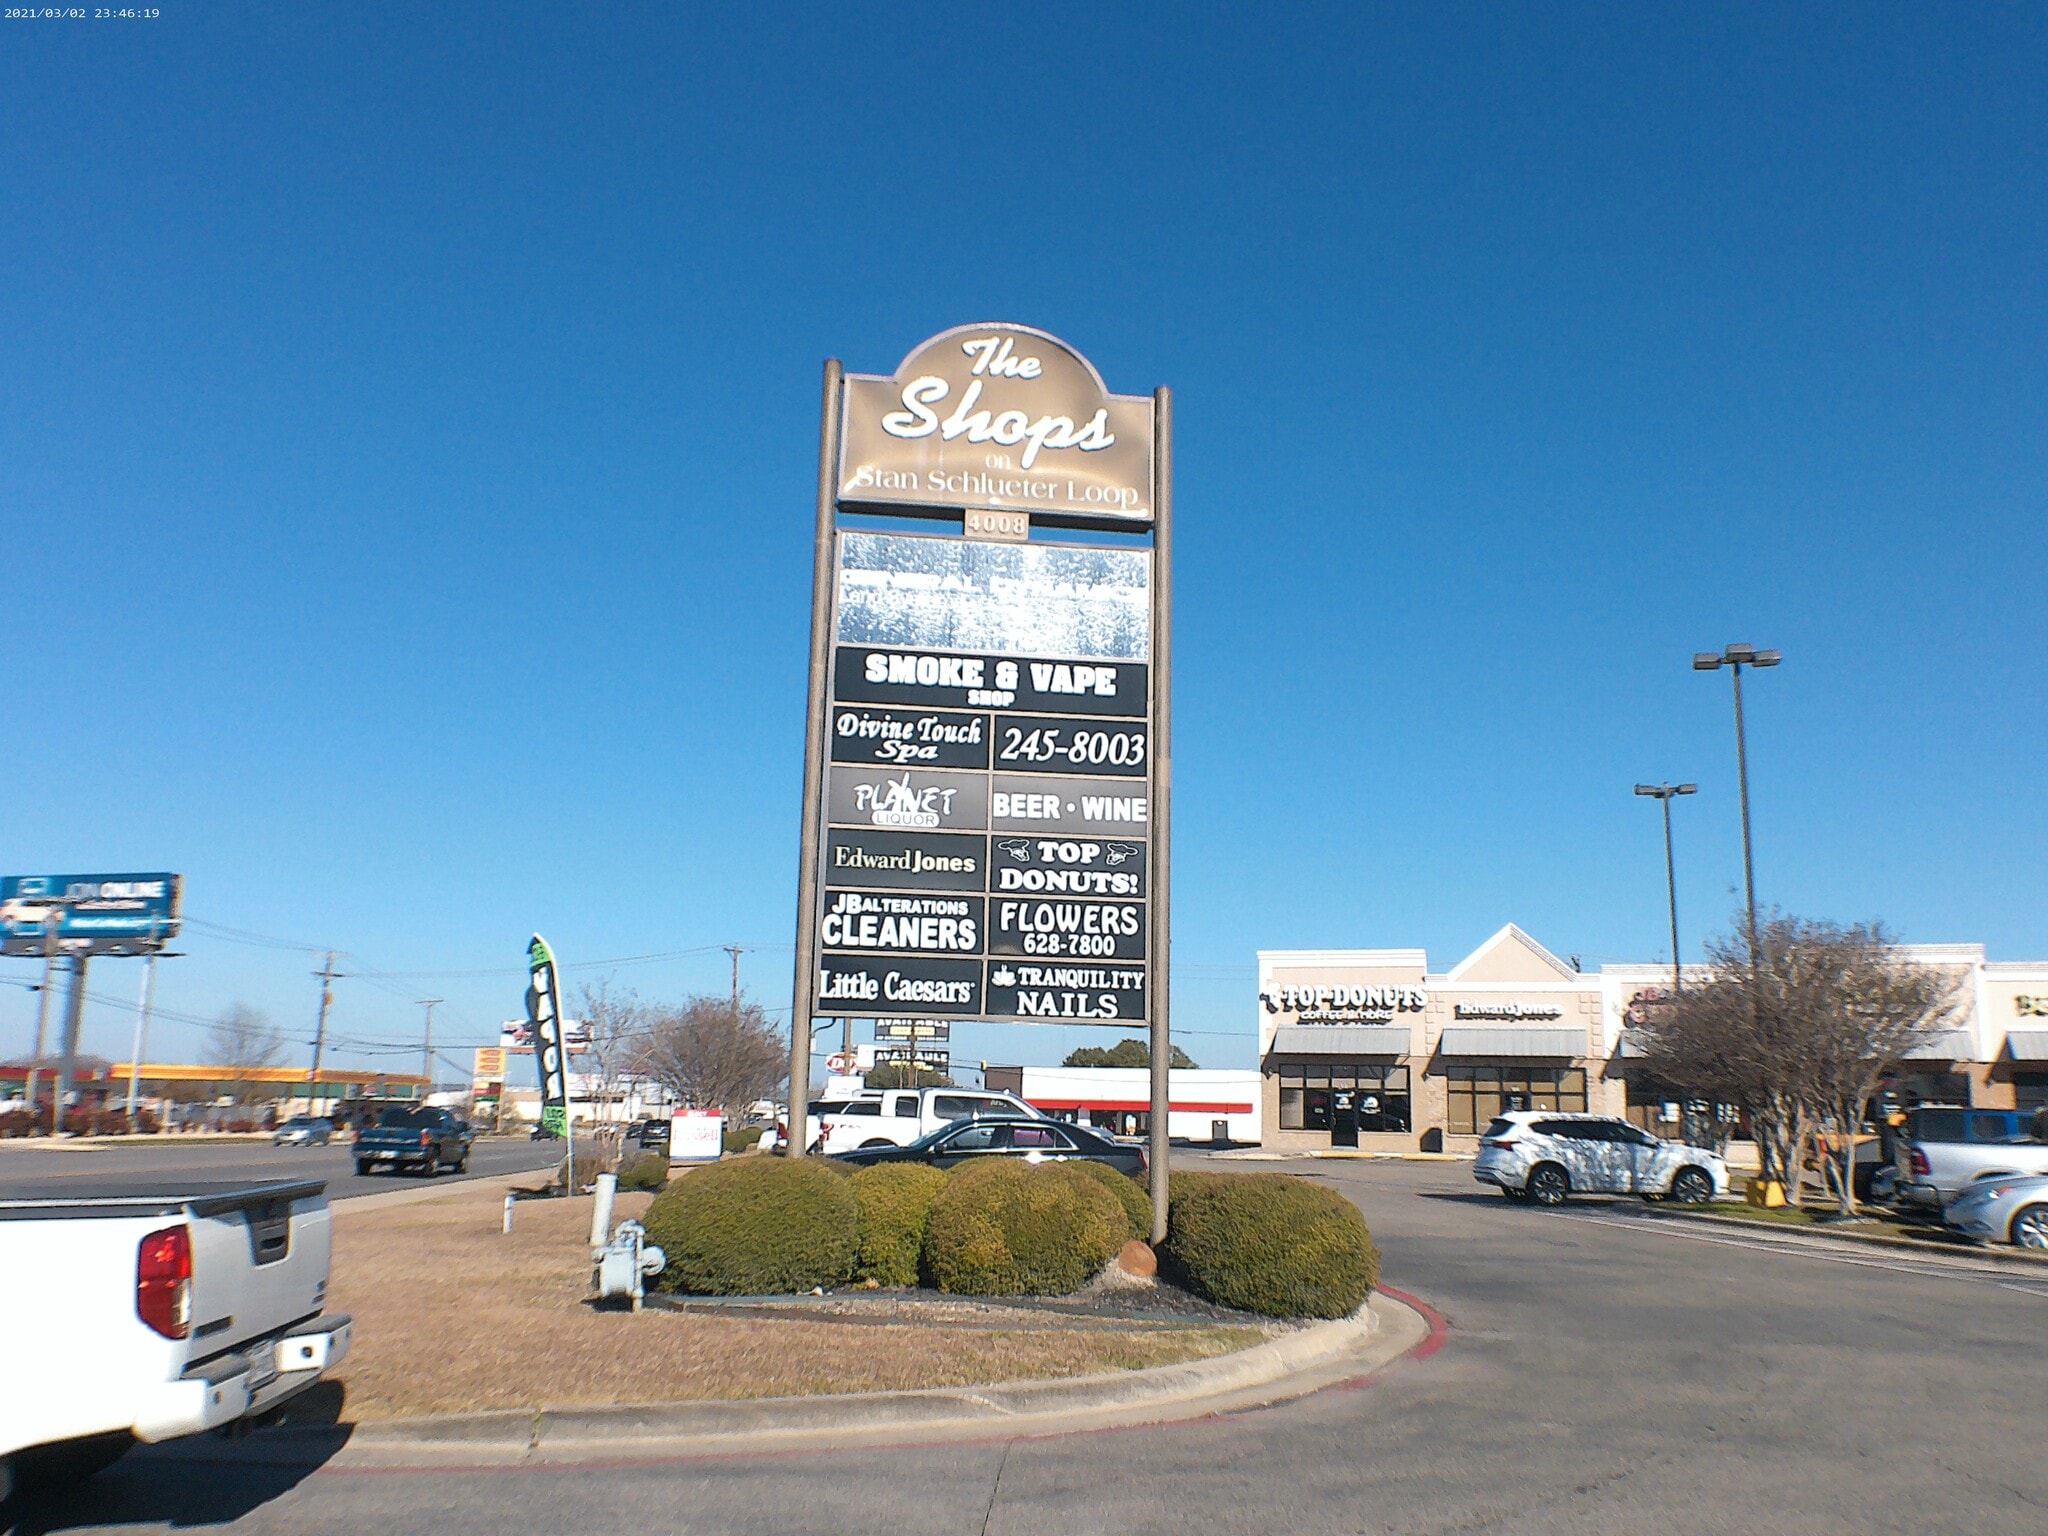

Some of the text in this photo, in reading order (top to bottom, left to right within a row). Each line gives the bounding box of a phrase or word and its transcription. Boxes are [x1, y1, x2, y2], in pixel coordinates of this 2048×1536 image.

[961, 336, 1042, 379] The
[882, 376, 1114, 469] Shops
[985, 454, 1012, 470] on
[855, 465, 1139, 510] Stan Schlueter Loop
[967, 515, 1026, 535] 4008
[865, 653, 1117, 697] SMOKE & VAPE
[967, 689, 1015, 707] SHOP
[836, 713, 982, 744] Divine Touch
[874, 740, 939, 763] Spa
[1000, 727, 1145, 766] 245-8003
[853, 771, 958, 815] PLANET
[992, 792, 1147, 822] BEER WINE
[876, 813, 935, 826] LIQUOR
[1037, 841, 1101, 864] TOP
[999, 868, 1138, 895] DONUTS!
[821, 914, 977, 950] CLEANERS
[1000, 902, 1139, 935] FLOWERS
[1023, 933, 1116, 956] 628-7800
[819, 970, 971, 1004] Little Caesars
[1017, 967, 1145, 989] TRANQUILITY
[1016, 991, 1119, 1018] NAILS
[1282, 984, 1429, 1007] TOP DONUTS
